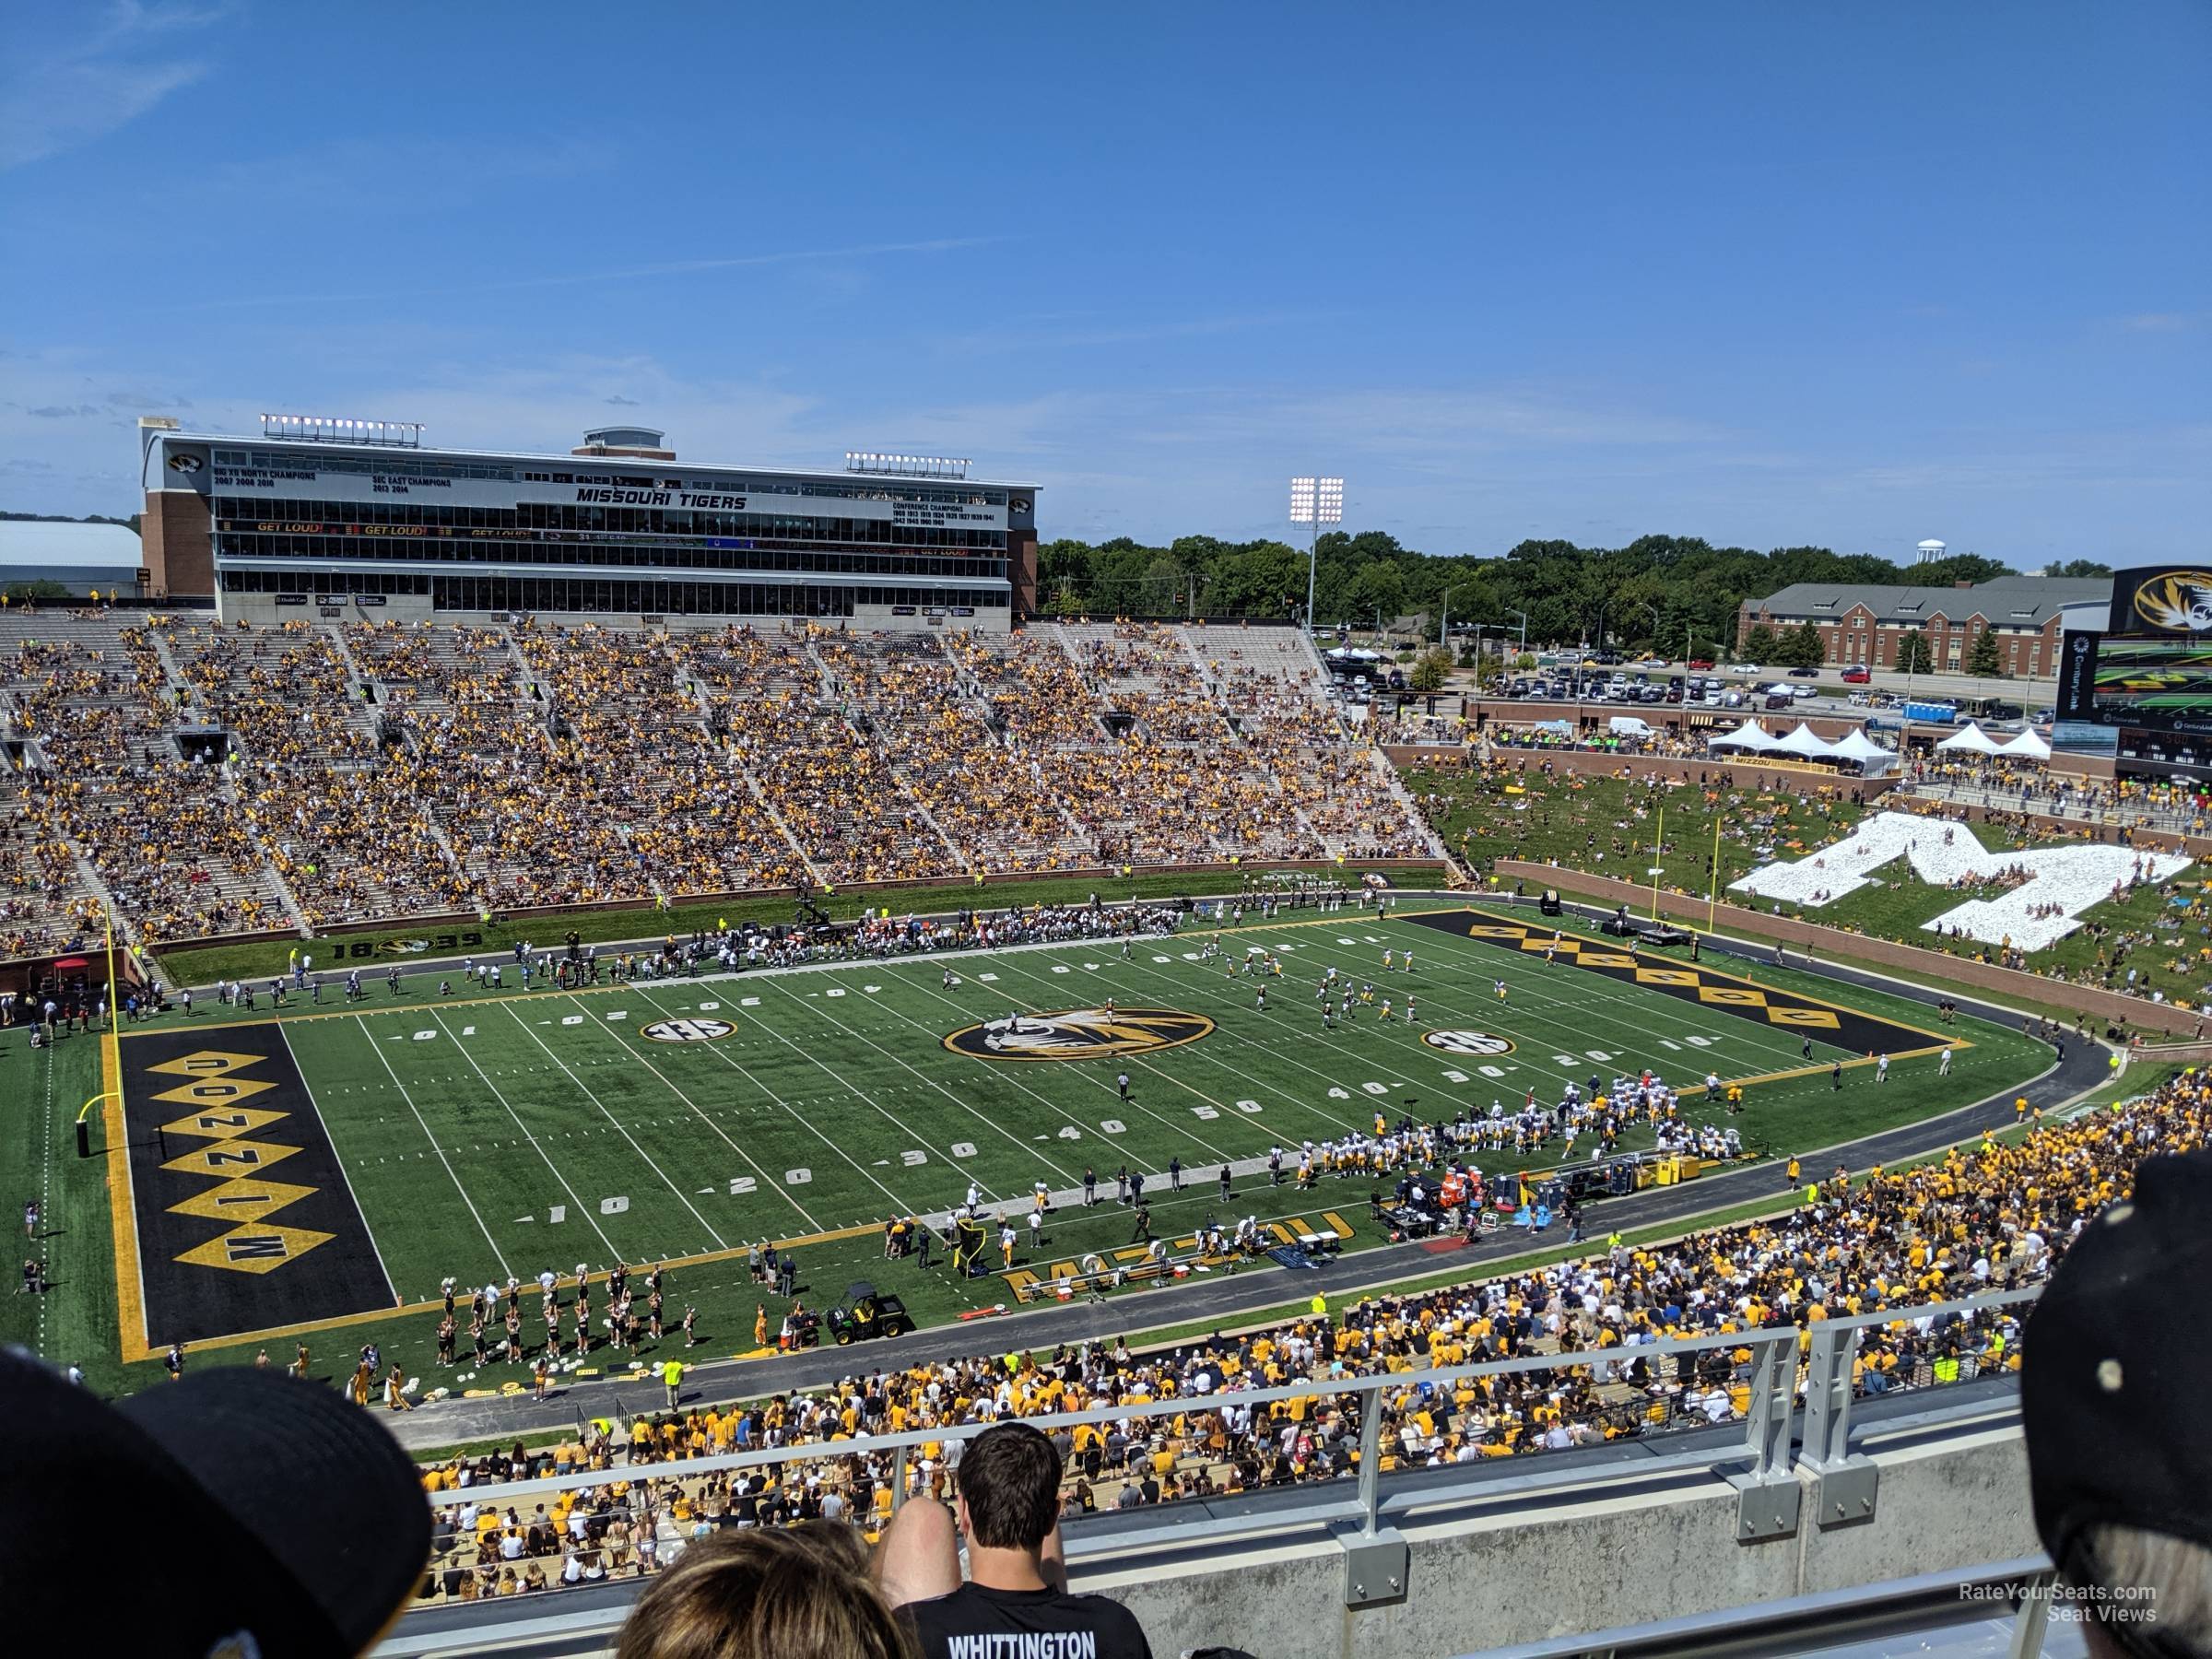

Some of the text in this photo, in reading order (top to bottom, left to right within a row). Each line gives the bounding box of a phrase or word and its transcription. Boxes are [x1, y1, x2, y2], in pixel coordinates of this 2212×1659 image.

[214, 477, 275, 487] 2007 2008 2010
[241, 469, 268, 478] NORTH
[270, 471, 316, 480] CHAMPIONS
[371, 476, 452, 488] SEC EAST CHAMPIONS
[372, 485, 408, 494] 2013 2014
[576, 488, 747, 510] MISSOURI TIGERS
[892, 502, 963, 512] CONFERENCE CHAMPIONS
[257, 522, 324, 533] GET LOUD!
[364, 525, 428, 536] GET LOUD!
[2069, 655, 2085, 711] CenturyLink
[1735, 757, 1771, 767] MIZZOU
[332, 933, 483, 959] 18 39
[647, 1018, 732, 1041] SEC
[1428, 1030, 1510, 1055] SEC
[1658, 1035, 1712, 1051] 10
[1551, 1050, 1613, 1066] 20
[1441, 1065, 1506, 1083] 30
[1328, 1082, 1389, 1099] 40
[1190, 1100, 1264, 1120] 50
[1058, 1120, 1126, 1140] 40
[183, 1057, 288, 1264] MIZZOU
[900, 1142, 978, 1166] 30
[730, 1168, 813, 1194] 20
[548, 1196, 629, 1224] 10
[947, 1630, 1096, 1659] WHITTINGTON
